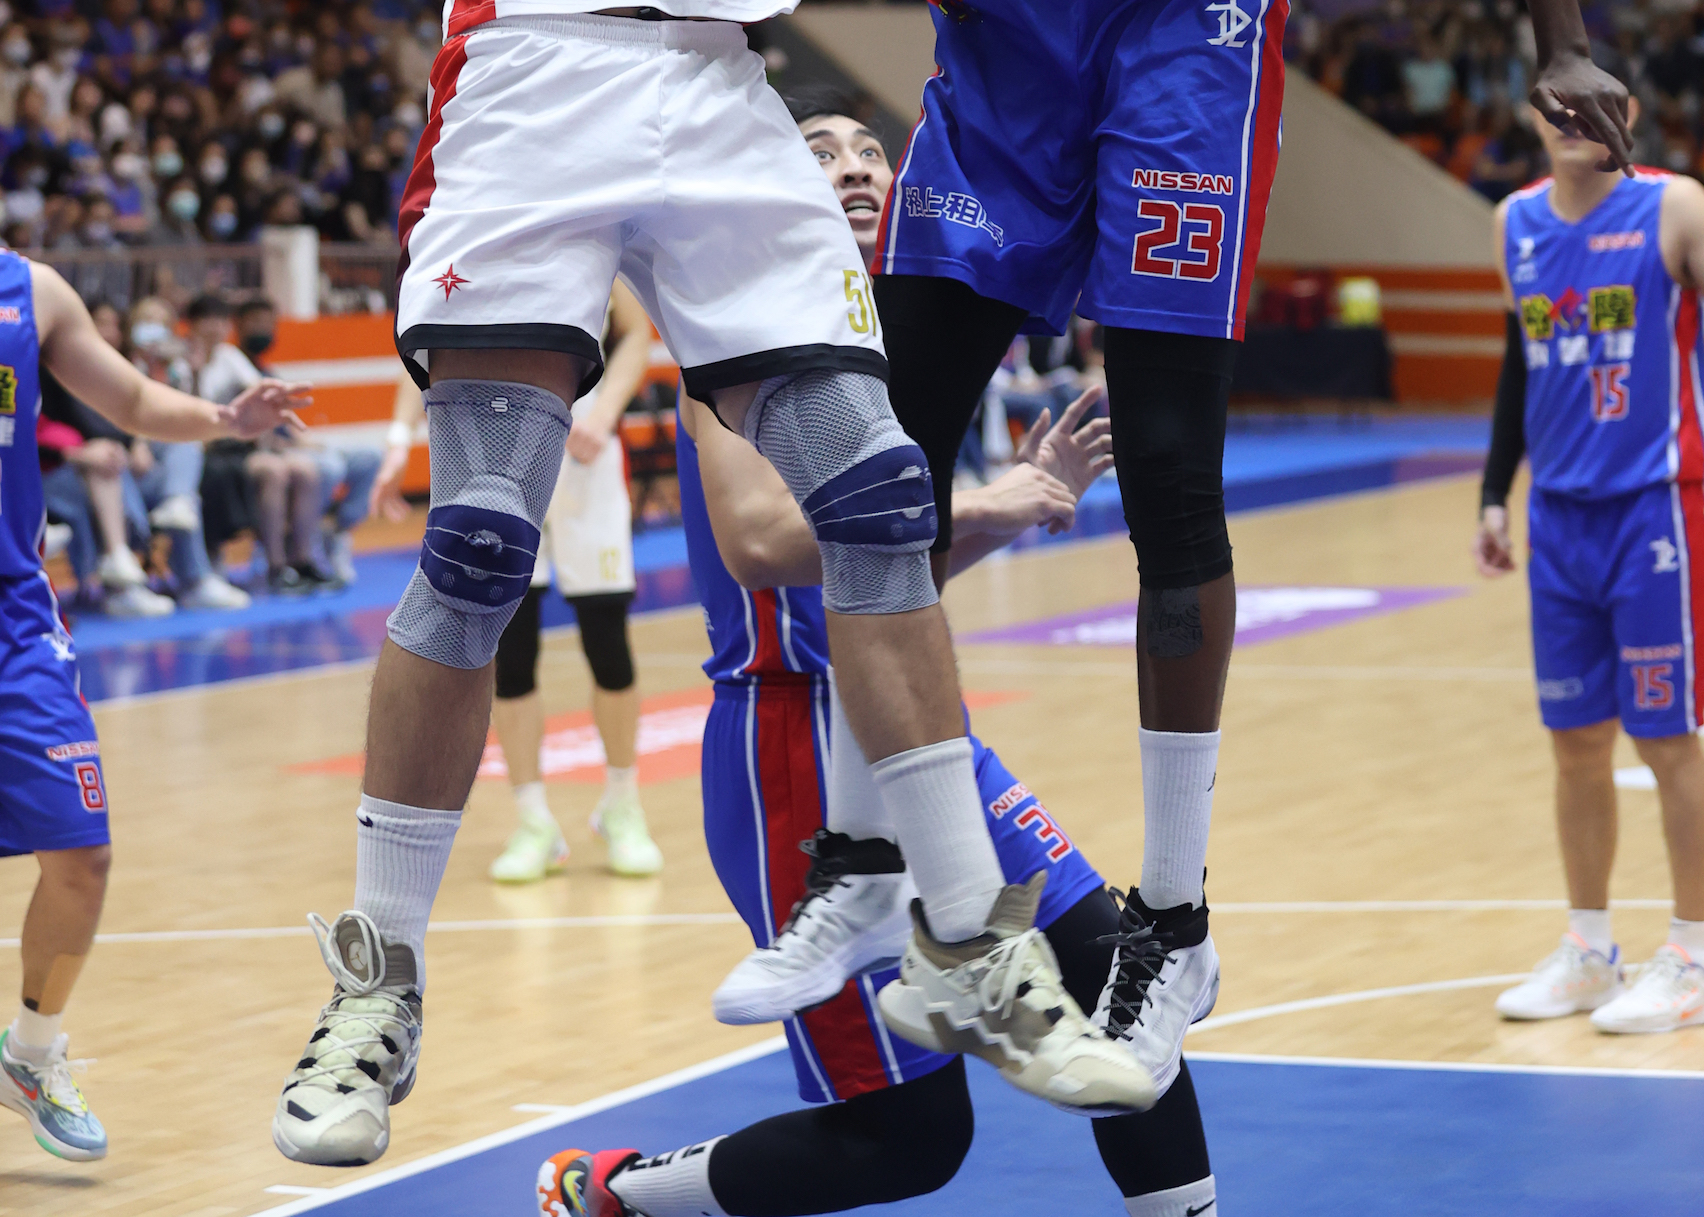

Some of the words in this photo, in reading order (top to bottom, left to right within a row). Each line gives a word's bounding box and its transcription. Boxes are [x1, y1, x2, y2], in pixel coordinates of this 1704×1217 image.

[1132, 169, 1234, 195] NISSAN
[1131, 199, 1225, 282] 23
[1588, 363, 1630, 422] 15
[1631, 663, 1675, 712] 15
[74, 761, 106, 812] 8
[1013, 801, 1076, 864] 3
